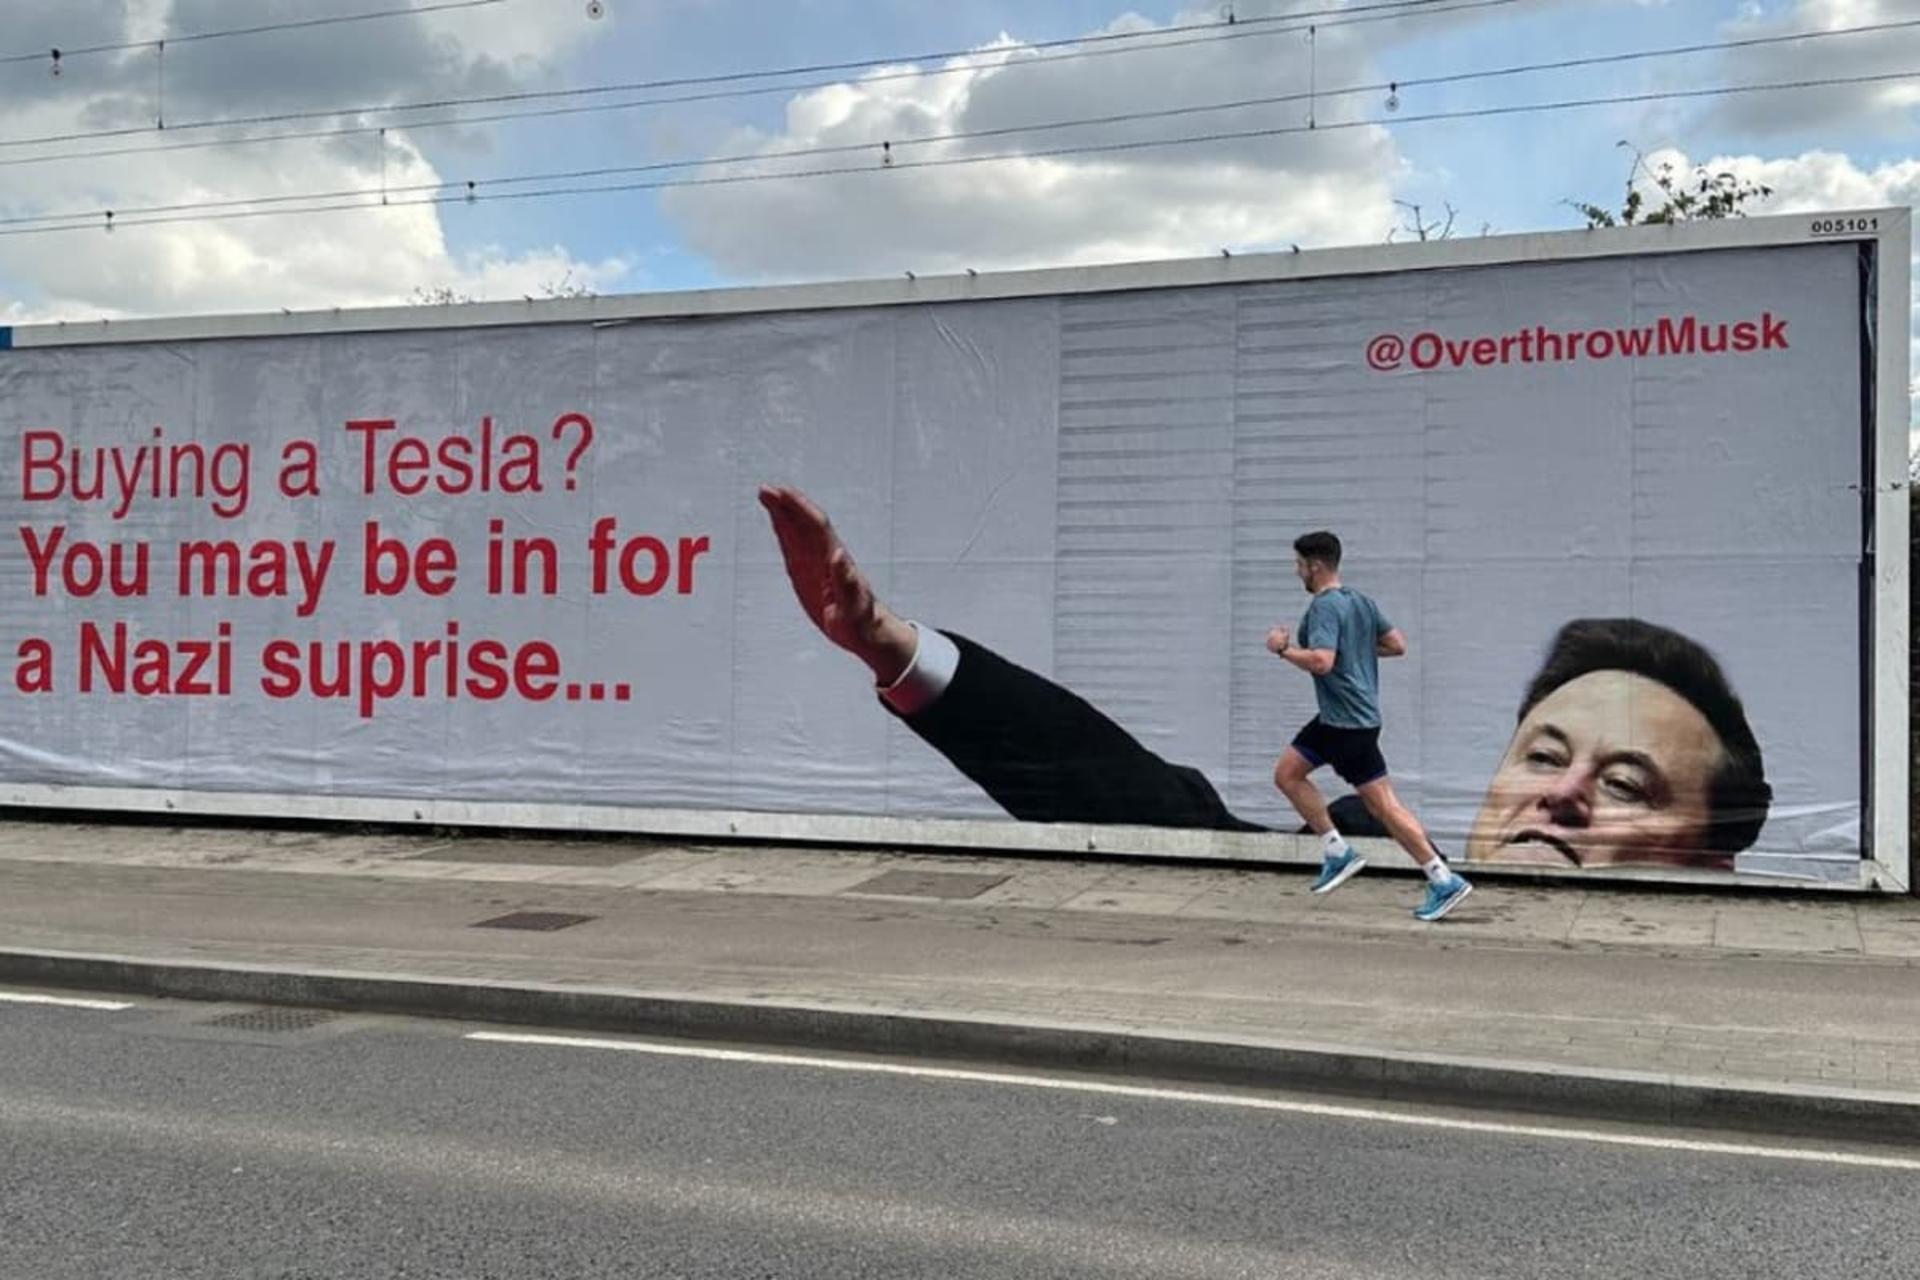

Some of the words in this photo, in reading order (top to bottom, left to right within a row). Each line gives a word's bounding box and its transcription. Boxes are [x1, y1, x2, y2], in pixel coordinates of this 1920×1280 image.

[1811, 217, 1878, 233] 005101
[1366, 313, 1789, 371] @OverthrowMusk
[21, 427, 250, 519] Buying
[279, 440, 320, 497] a
[345, 413, 594, 496] Tesla?
[20, 526, 149, 598] You
[179, 538, 335, 617] may
[364, 521, 458, 597] be
[487, 518, 559, 596] in
[589, 516, 710, 597] for
[15, 637, 53, 693] a
[79, 621, 232, 697] Nazi
[261, 621, 631, 719] suprise...
